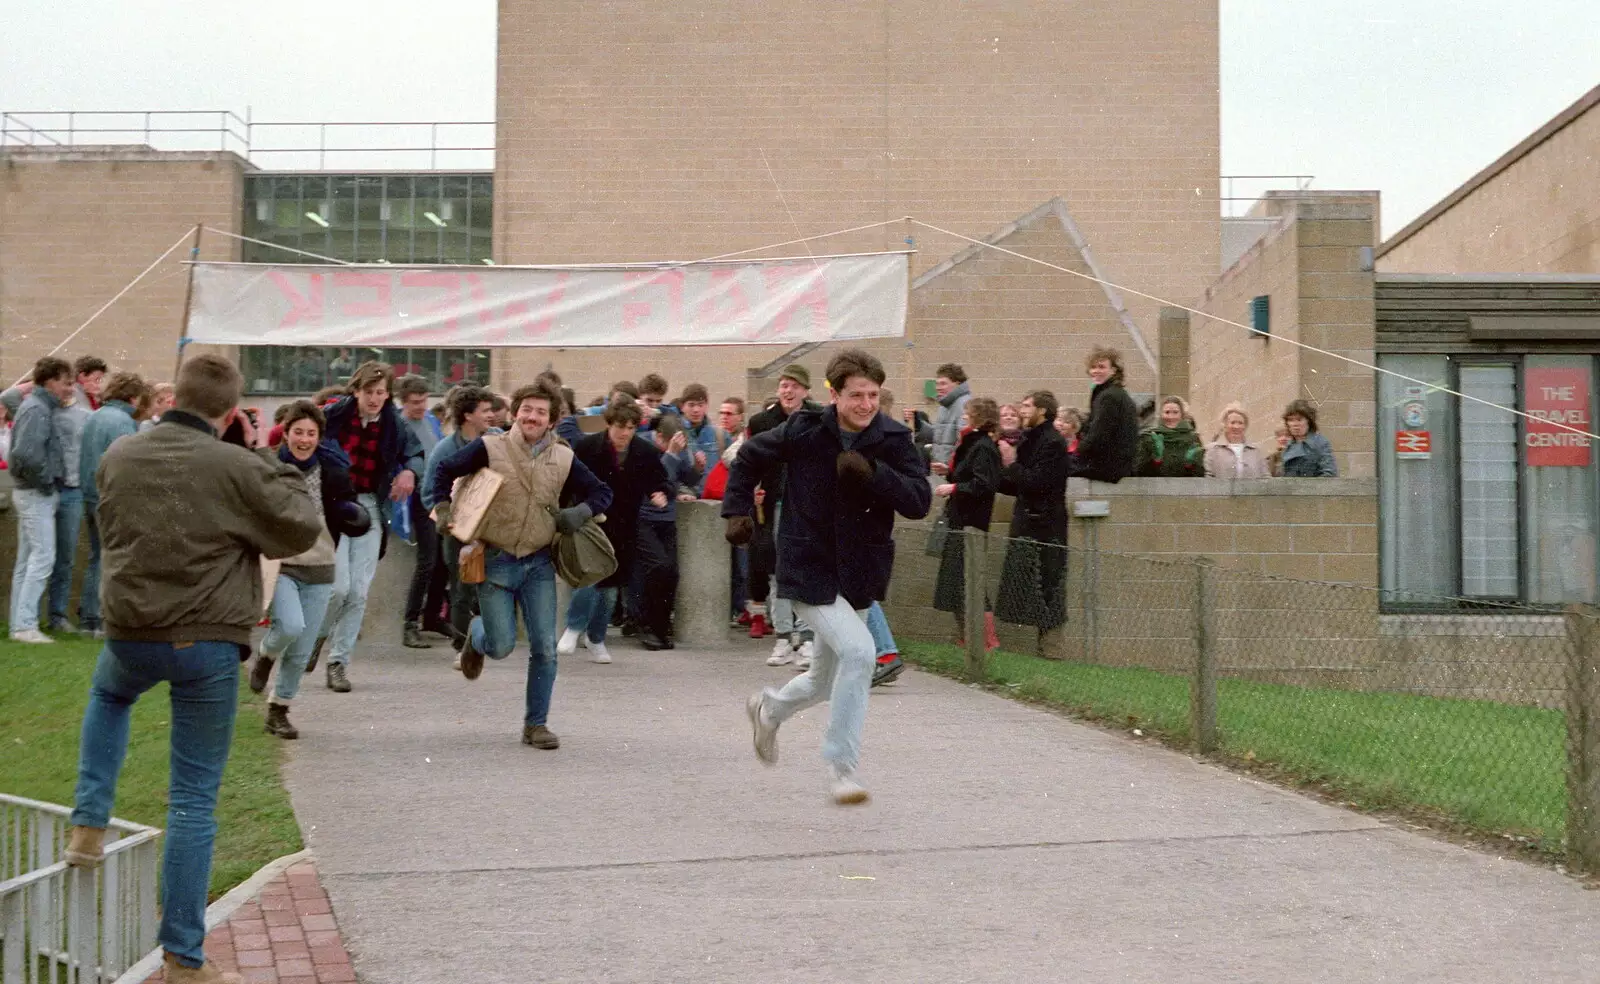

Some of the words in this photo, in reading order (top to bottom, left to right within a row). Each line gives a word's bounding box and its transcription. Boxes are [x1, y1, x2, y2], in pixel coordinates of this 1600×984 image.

[1540, 387, 1576, 401] THE
[1526, 409, 1589, 424] TRAVEL
[1525, 433, 1591, 447] CENTRE
